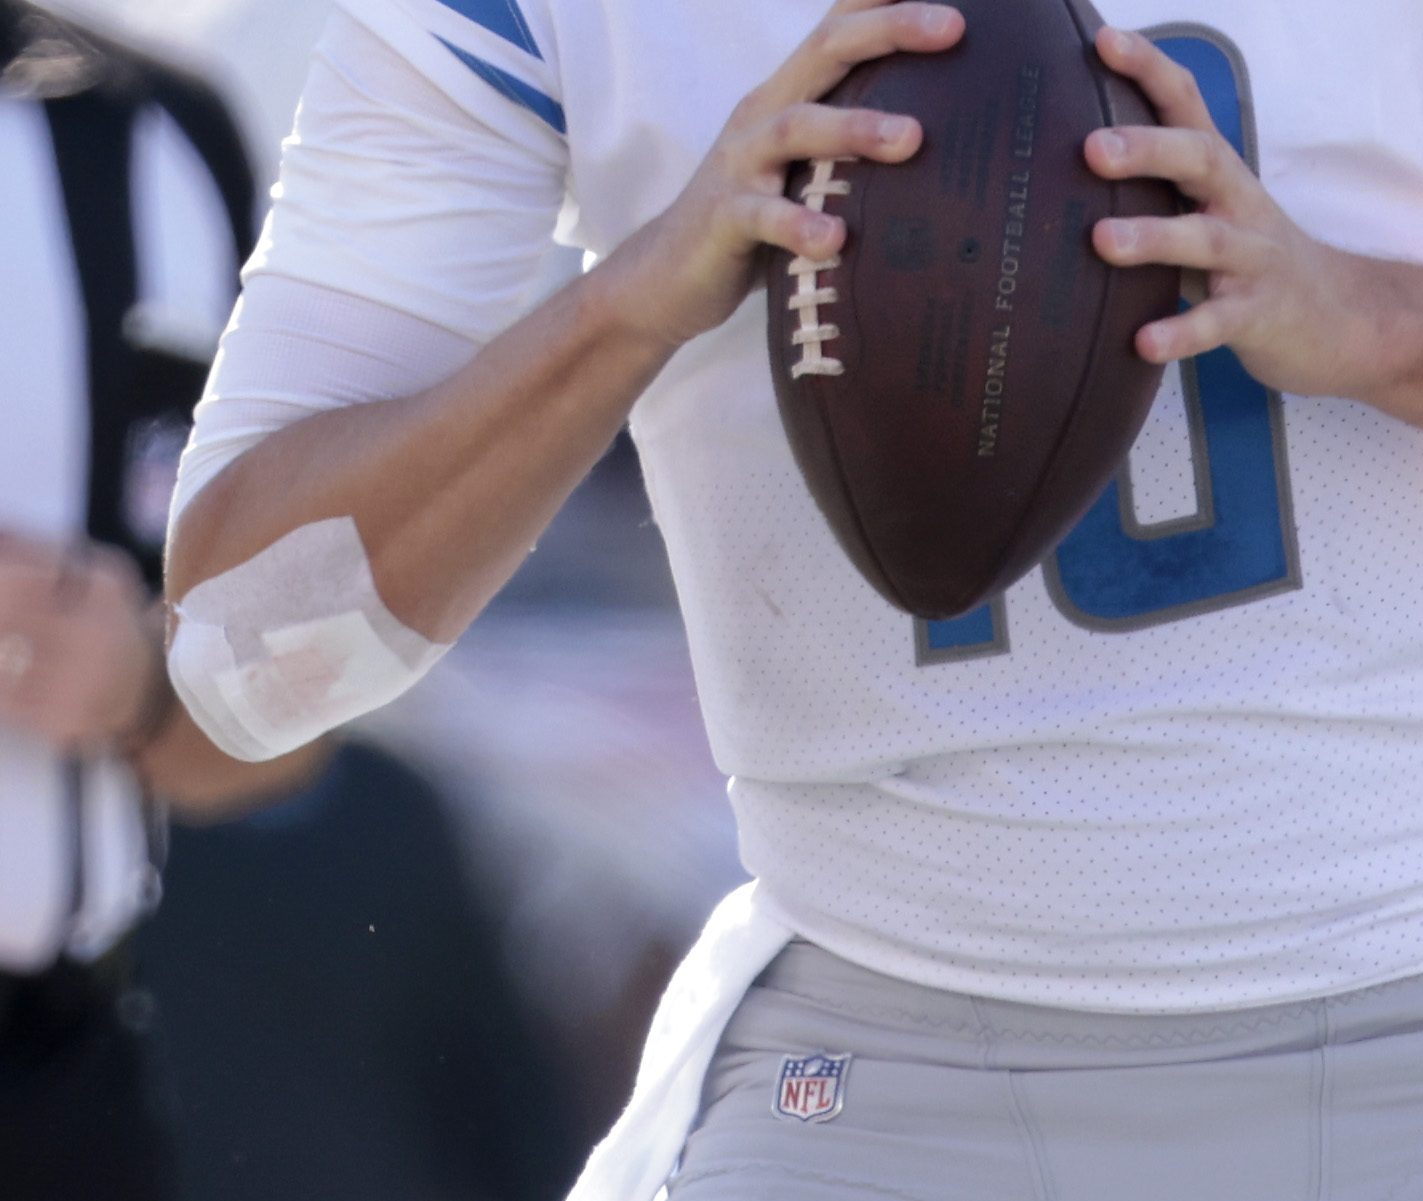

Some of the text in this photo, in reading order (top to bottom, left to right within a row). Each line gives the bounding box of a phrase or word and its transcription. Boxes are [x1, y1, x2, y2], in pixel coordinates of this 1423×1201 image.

[977, 325, 1011, 456] NATIONAL
[995, 170, 1031, 312] FOOTBALL
[783, 1079, 831, 1113] NFL
